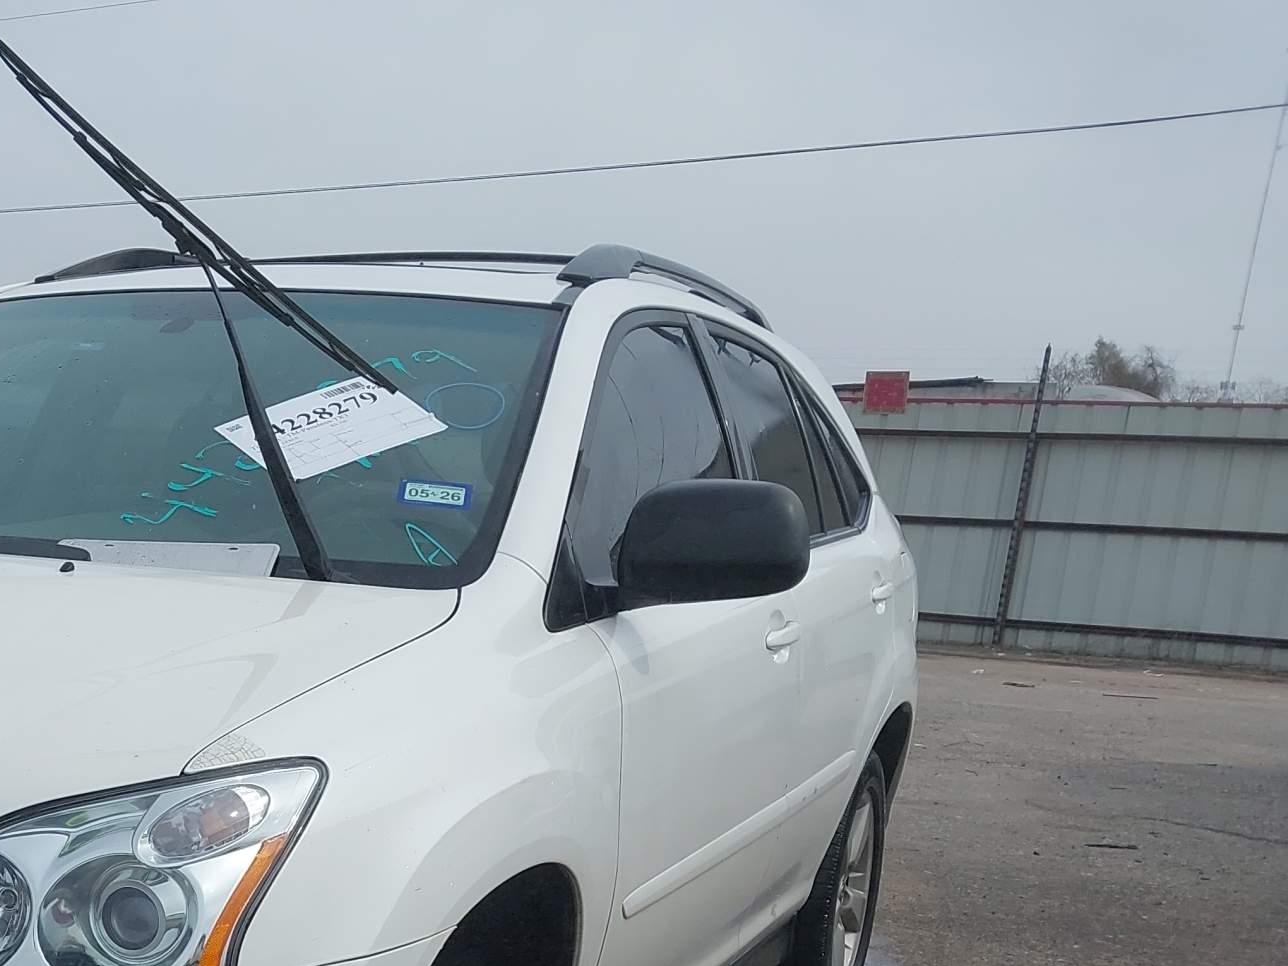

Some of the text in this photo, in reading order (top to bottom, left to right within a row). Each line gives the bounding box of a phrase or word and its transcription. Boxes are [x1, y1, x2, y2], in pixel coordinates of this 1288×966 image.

[256, 390, 379, 440] 4228279
[408, 487, 462, 502] 05 26
